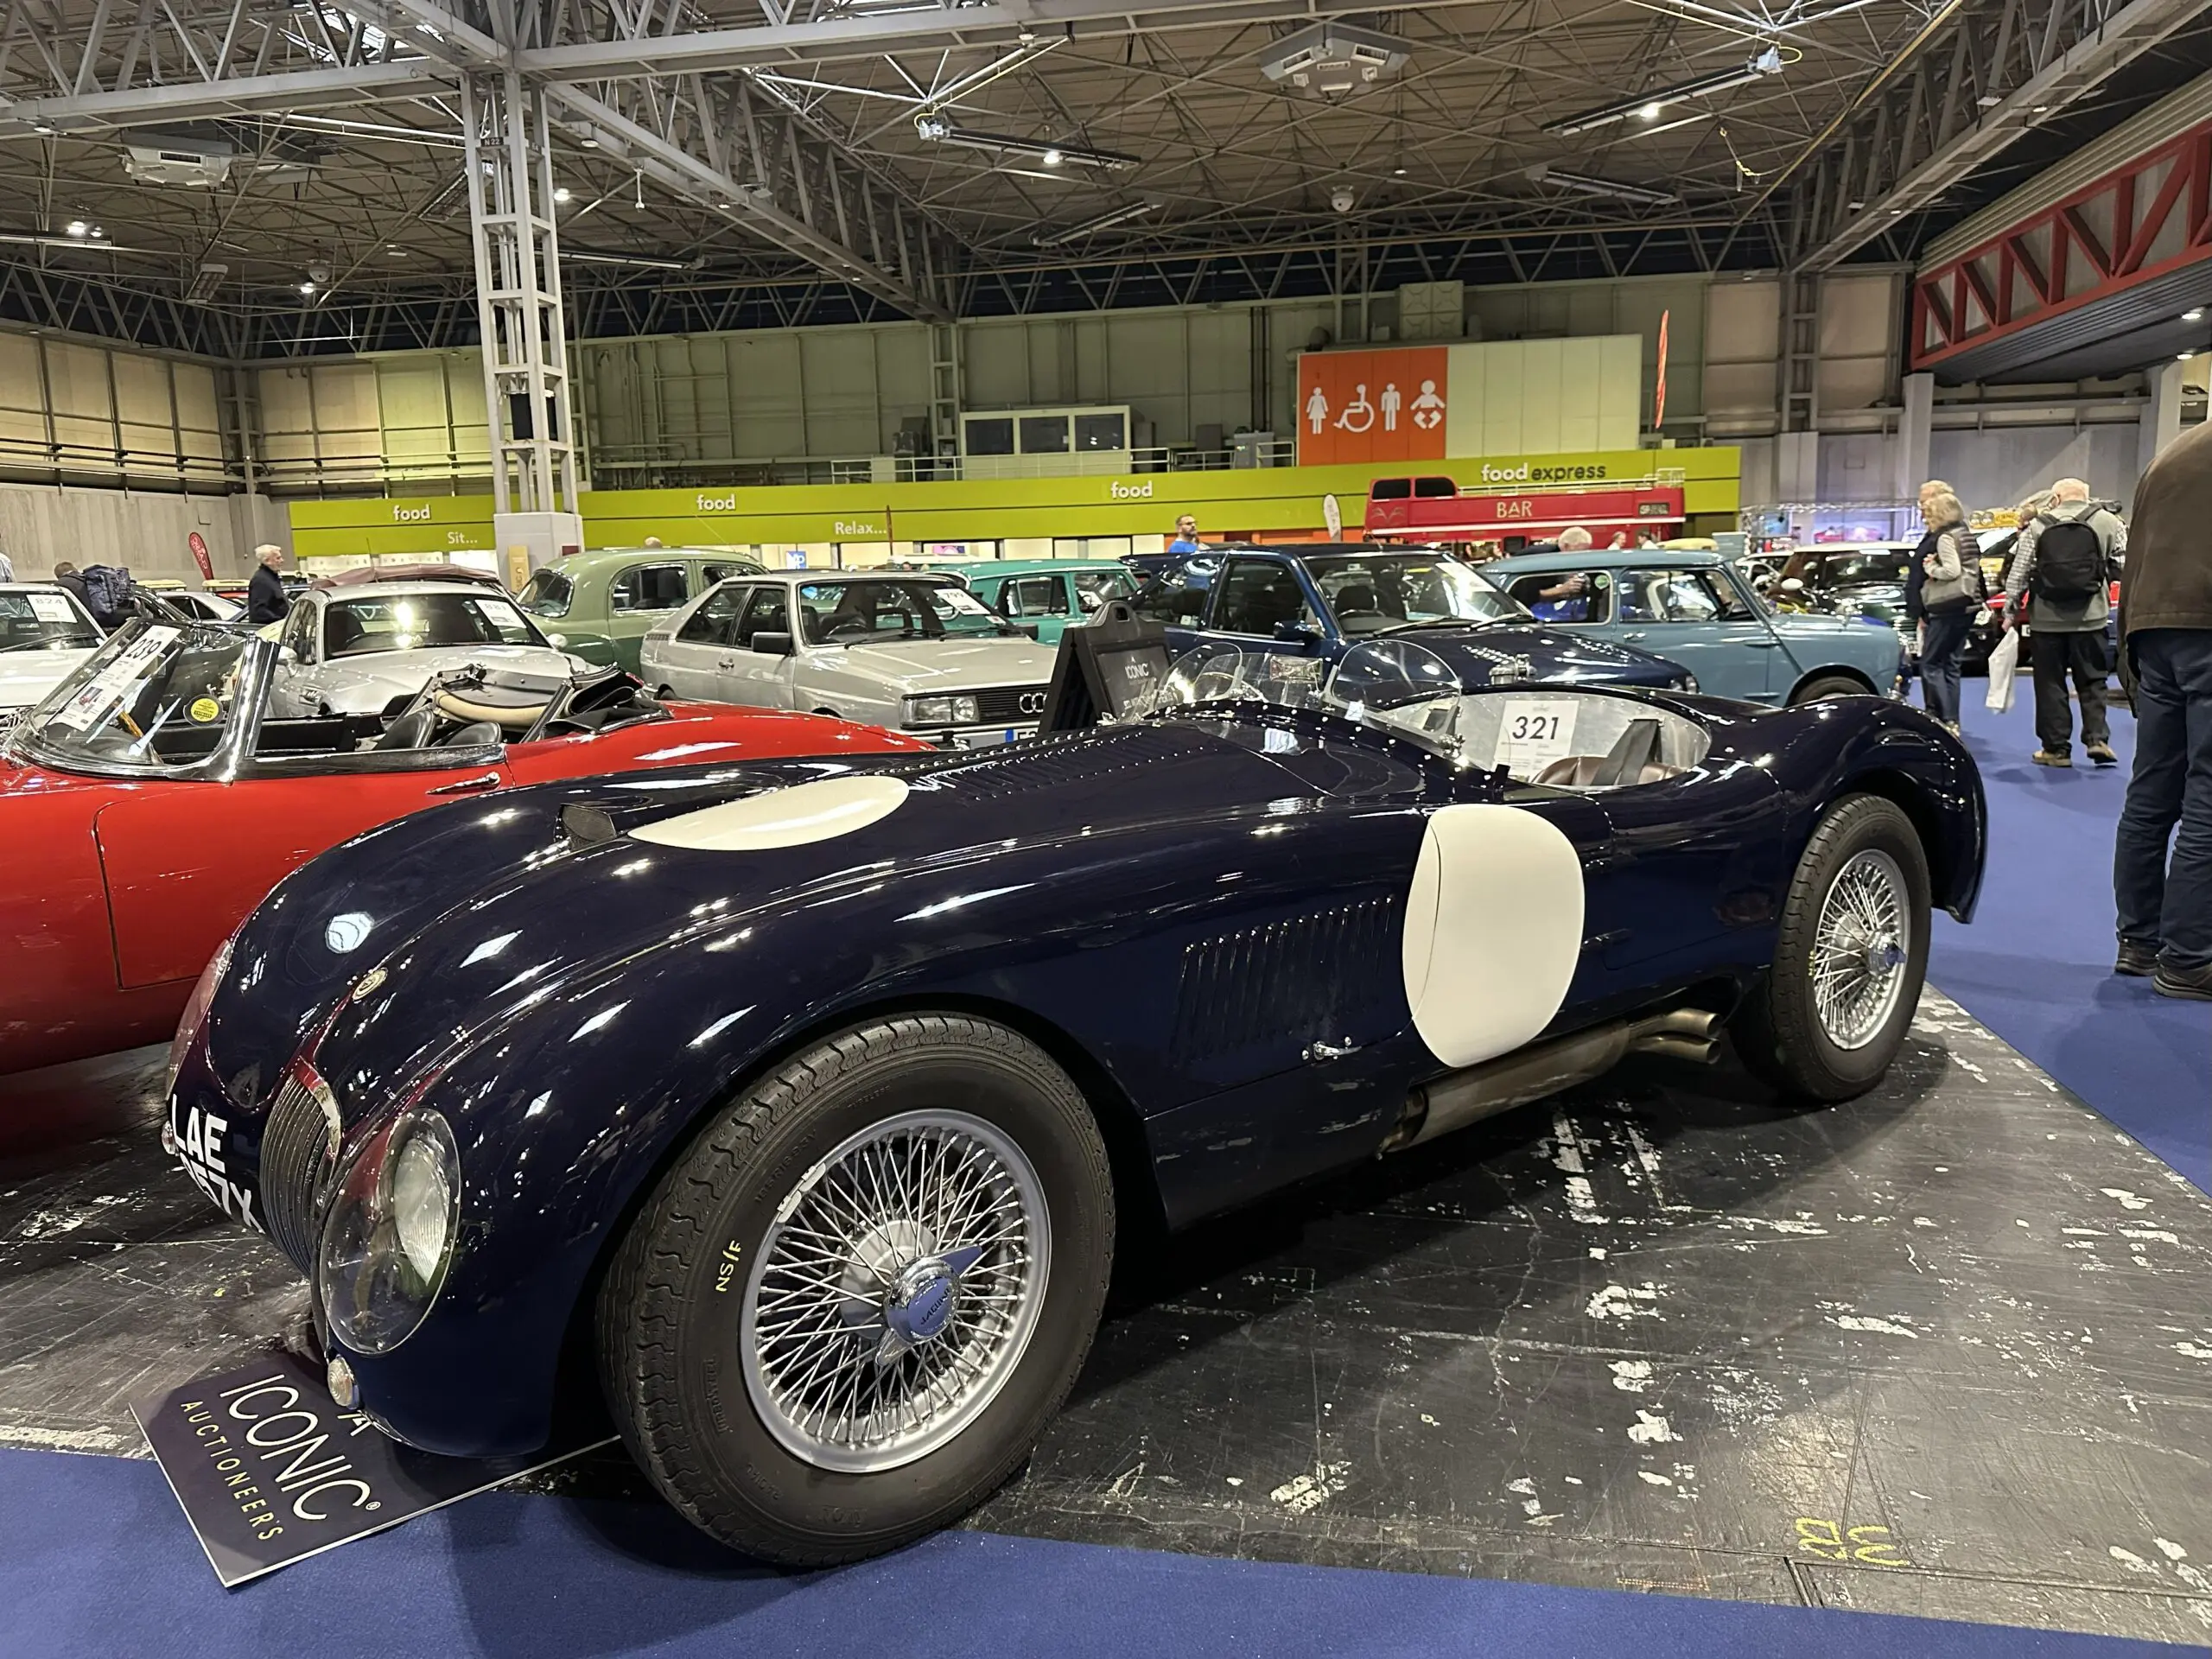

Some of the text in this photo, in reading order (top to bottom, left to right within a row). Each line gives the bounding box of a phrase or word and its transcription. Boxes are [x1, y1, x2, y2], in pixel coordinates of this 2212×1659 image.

[1481, 462, 1606, 483] food express
[1110, 480, 1153, 499] food
[696, 493, 736, 511] food
[1497, 500, 1533, 518] BAR
[393, 504, 431, 521] food
[835, 520, 887, 535] Relax...
[447, 531, 478, 544] Sit...
[125, 638, 162, 661] 239
[1124, 662, 1149, 679] ICONIC
[1512, 715, 1559, 741] 321
[172, 1093, 228, 1173] LAE
[715, 1240, 741, 1292] NS/F
[180, 1400, 283, 1541] AUCTIONEERS
